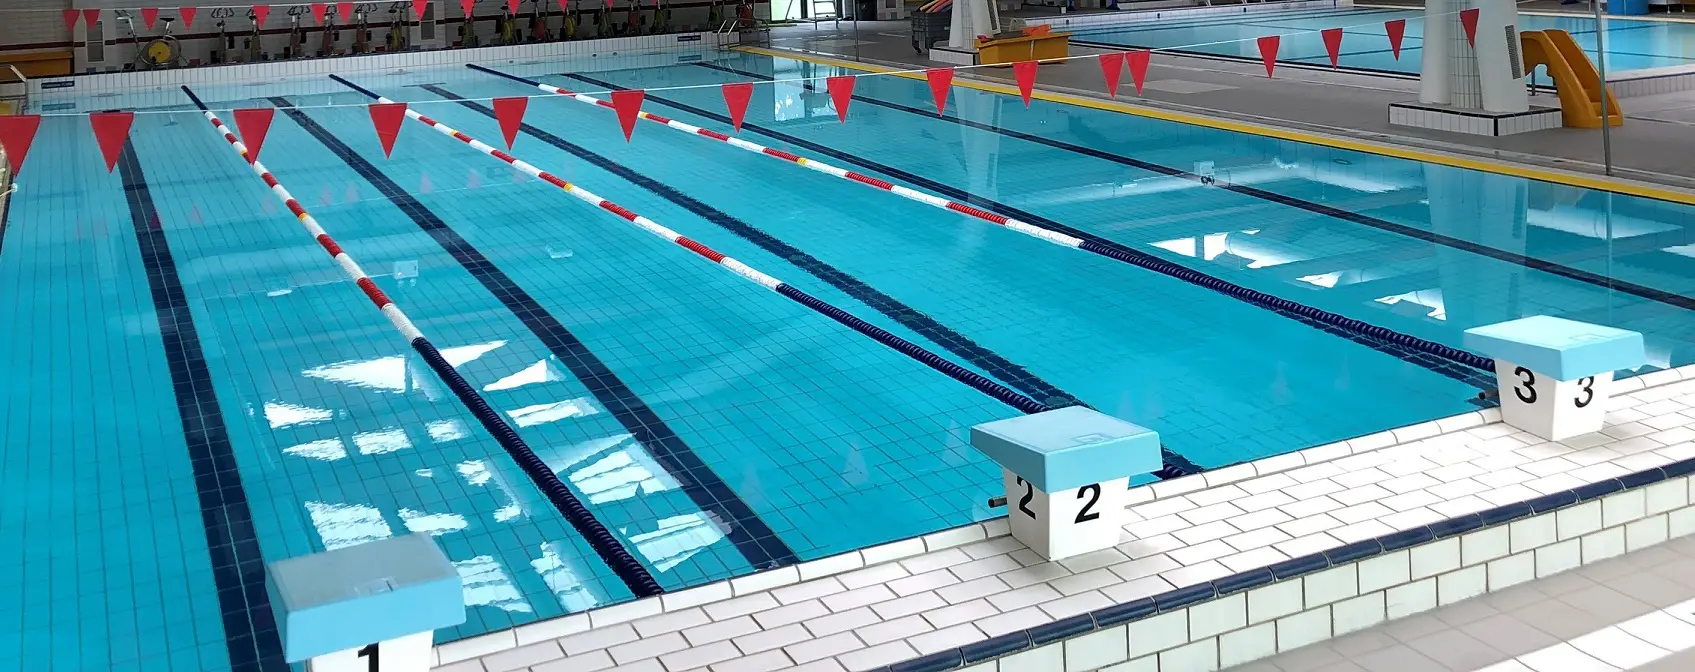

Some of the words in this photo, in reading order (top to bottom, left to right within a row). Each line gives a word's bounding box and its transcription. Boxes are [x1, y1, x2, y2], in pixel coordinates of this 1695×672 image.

[1514, 366, 1537, 404] 3
[1574, 376, 1594, 408] 3
[1016, 475, 1036, 520] 2
[1074, 483, 1101, 524] 2
[357, 641, 380, 672] 1
